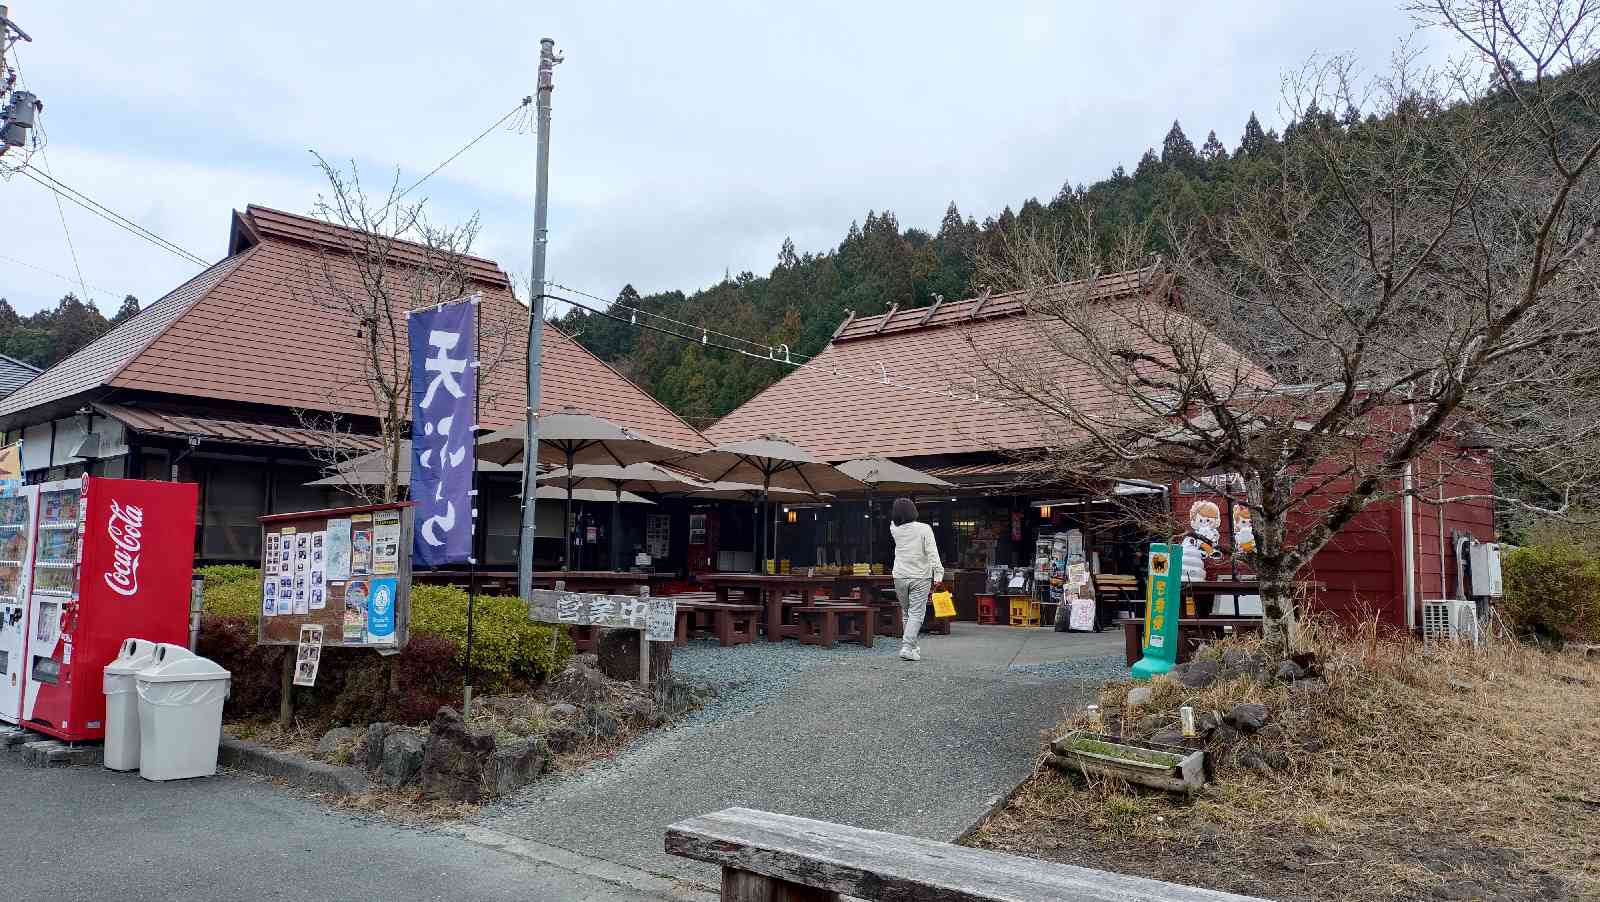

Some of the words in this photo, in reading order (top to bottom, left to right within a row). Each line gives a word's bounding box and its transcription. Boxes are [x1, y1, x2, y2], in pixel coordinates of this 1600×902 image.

[104, 498, 144, 596] Coca-Cola
[557, 593, 648, 627] 営業中
